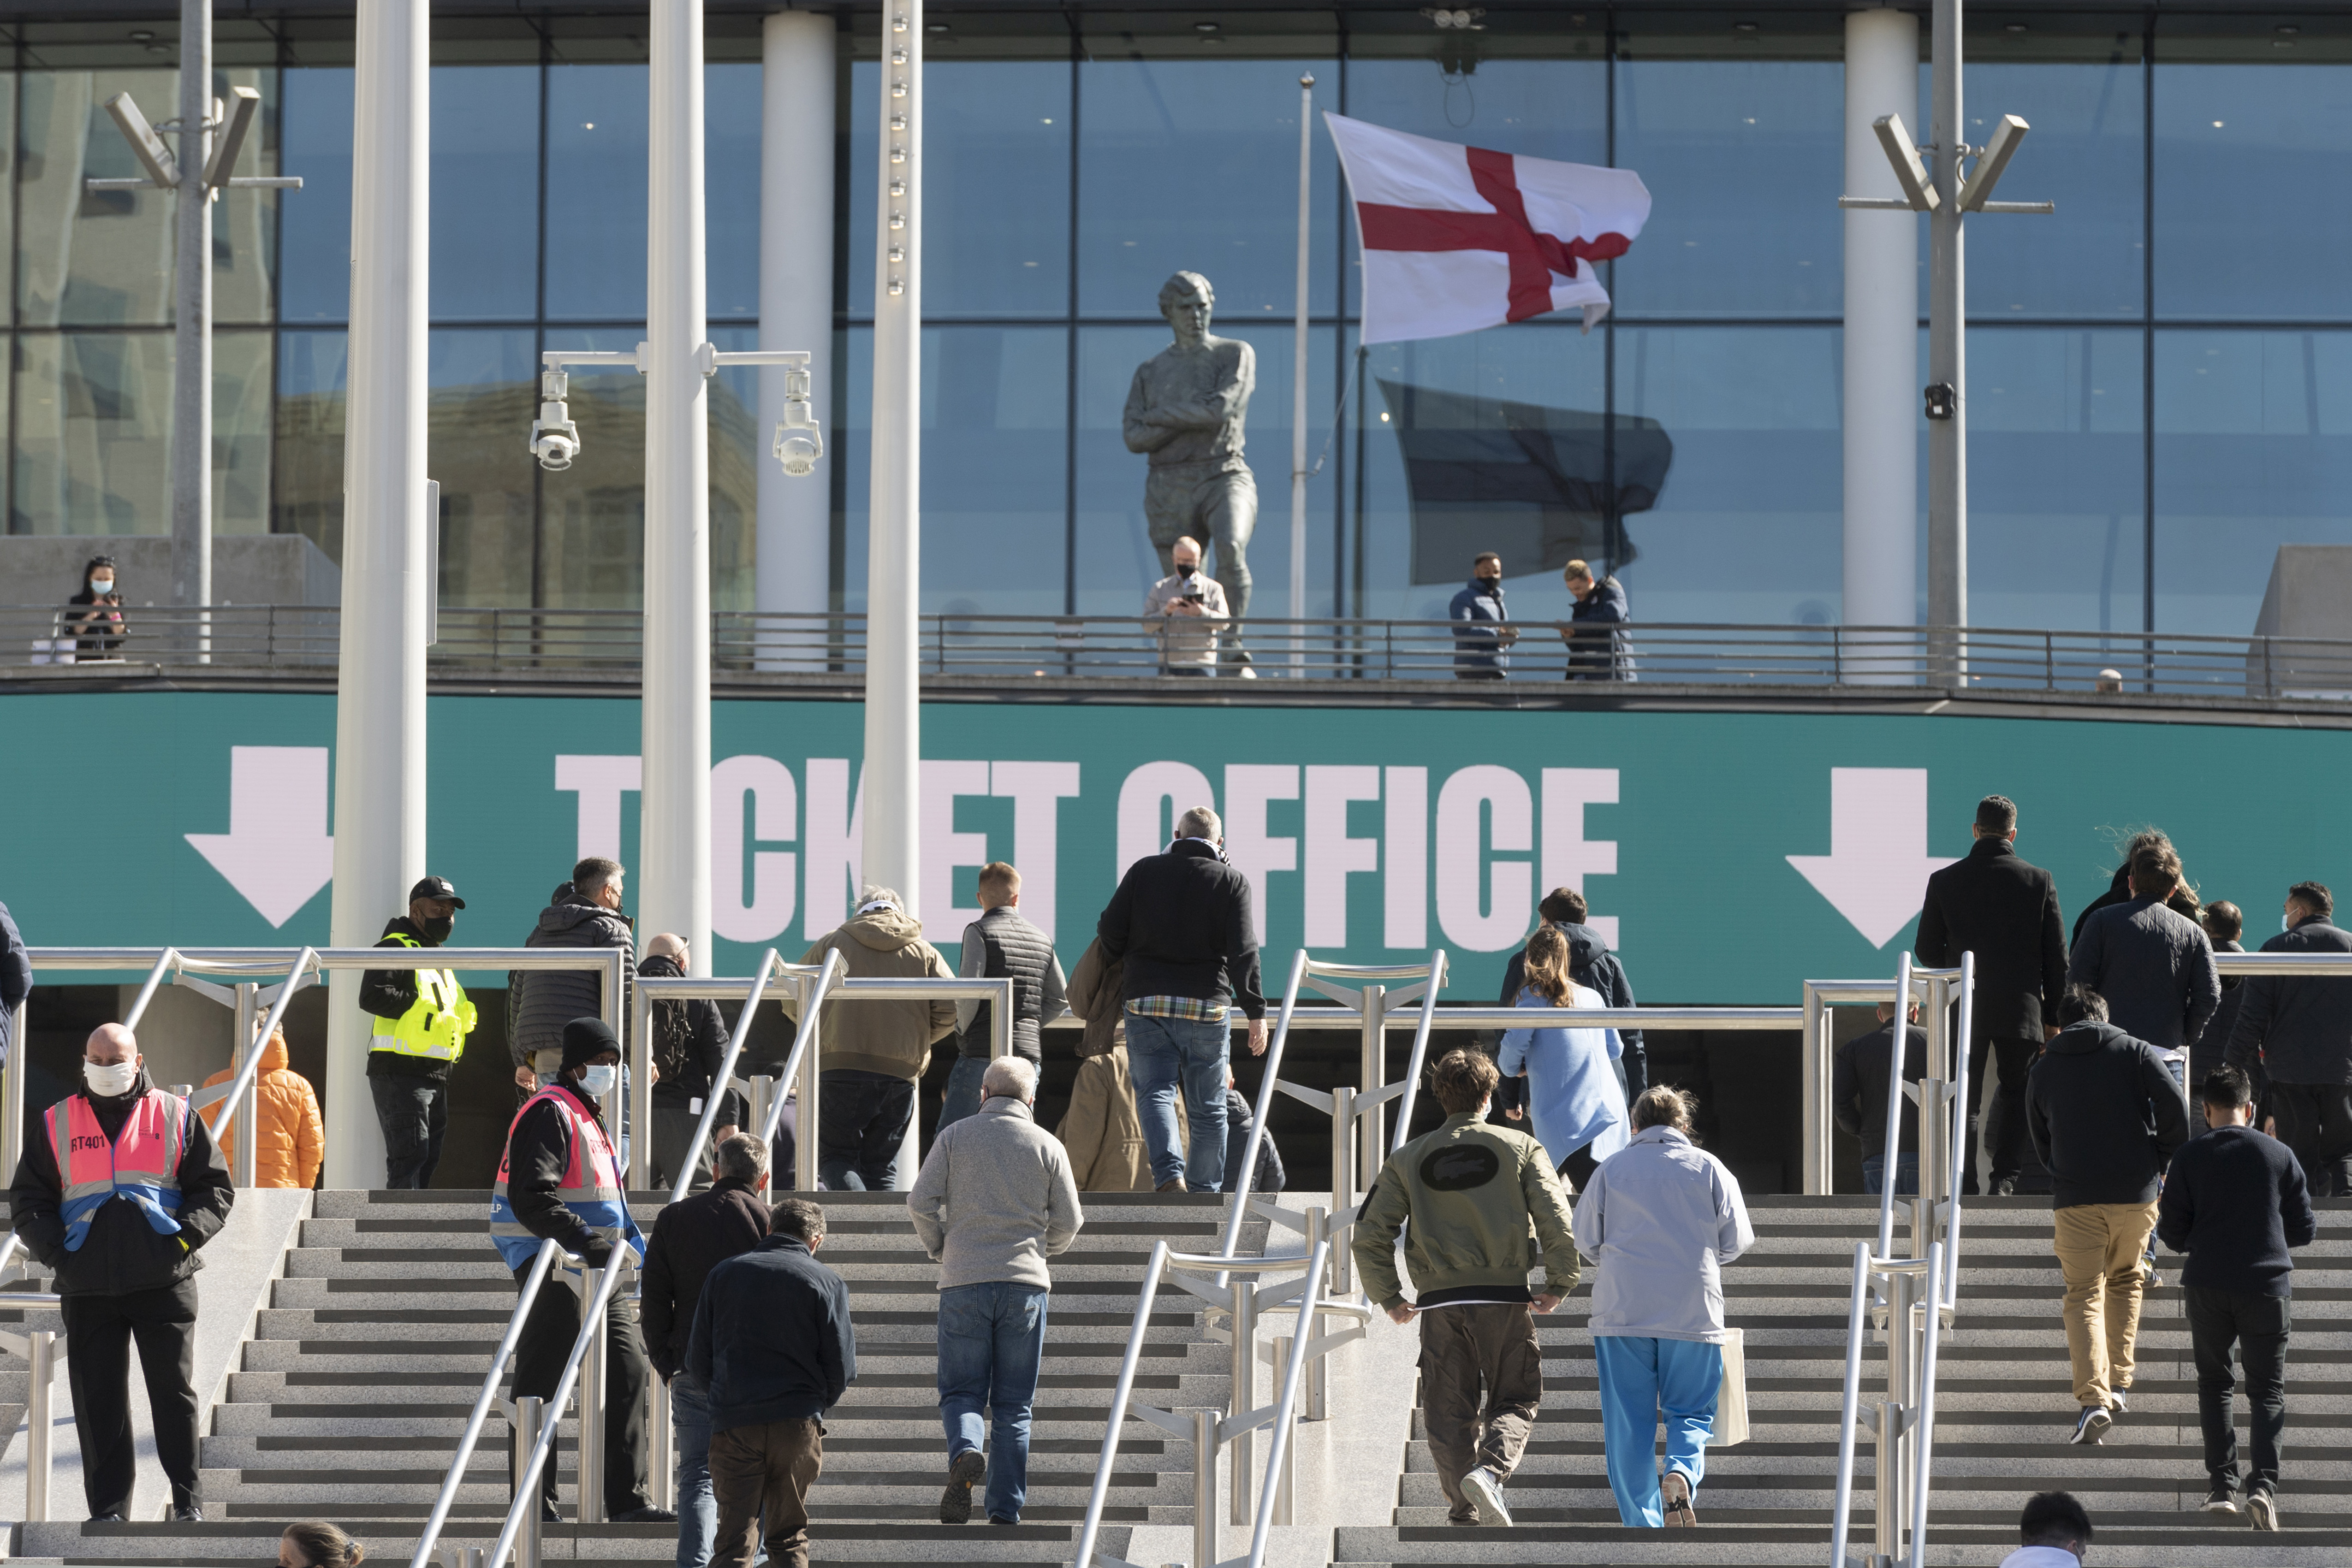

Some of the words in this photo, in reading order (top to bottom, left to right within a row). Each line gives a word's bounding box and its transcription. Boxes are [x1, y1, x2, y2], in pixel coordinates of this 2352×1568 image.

[555, 755, 1080, 945] TCKET
[71, 1134, 105, 1153] RT401
[491, 1203, 502, 1213] ELP
